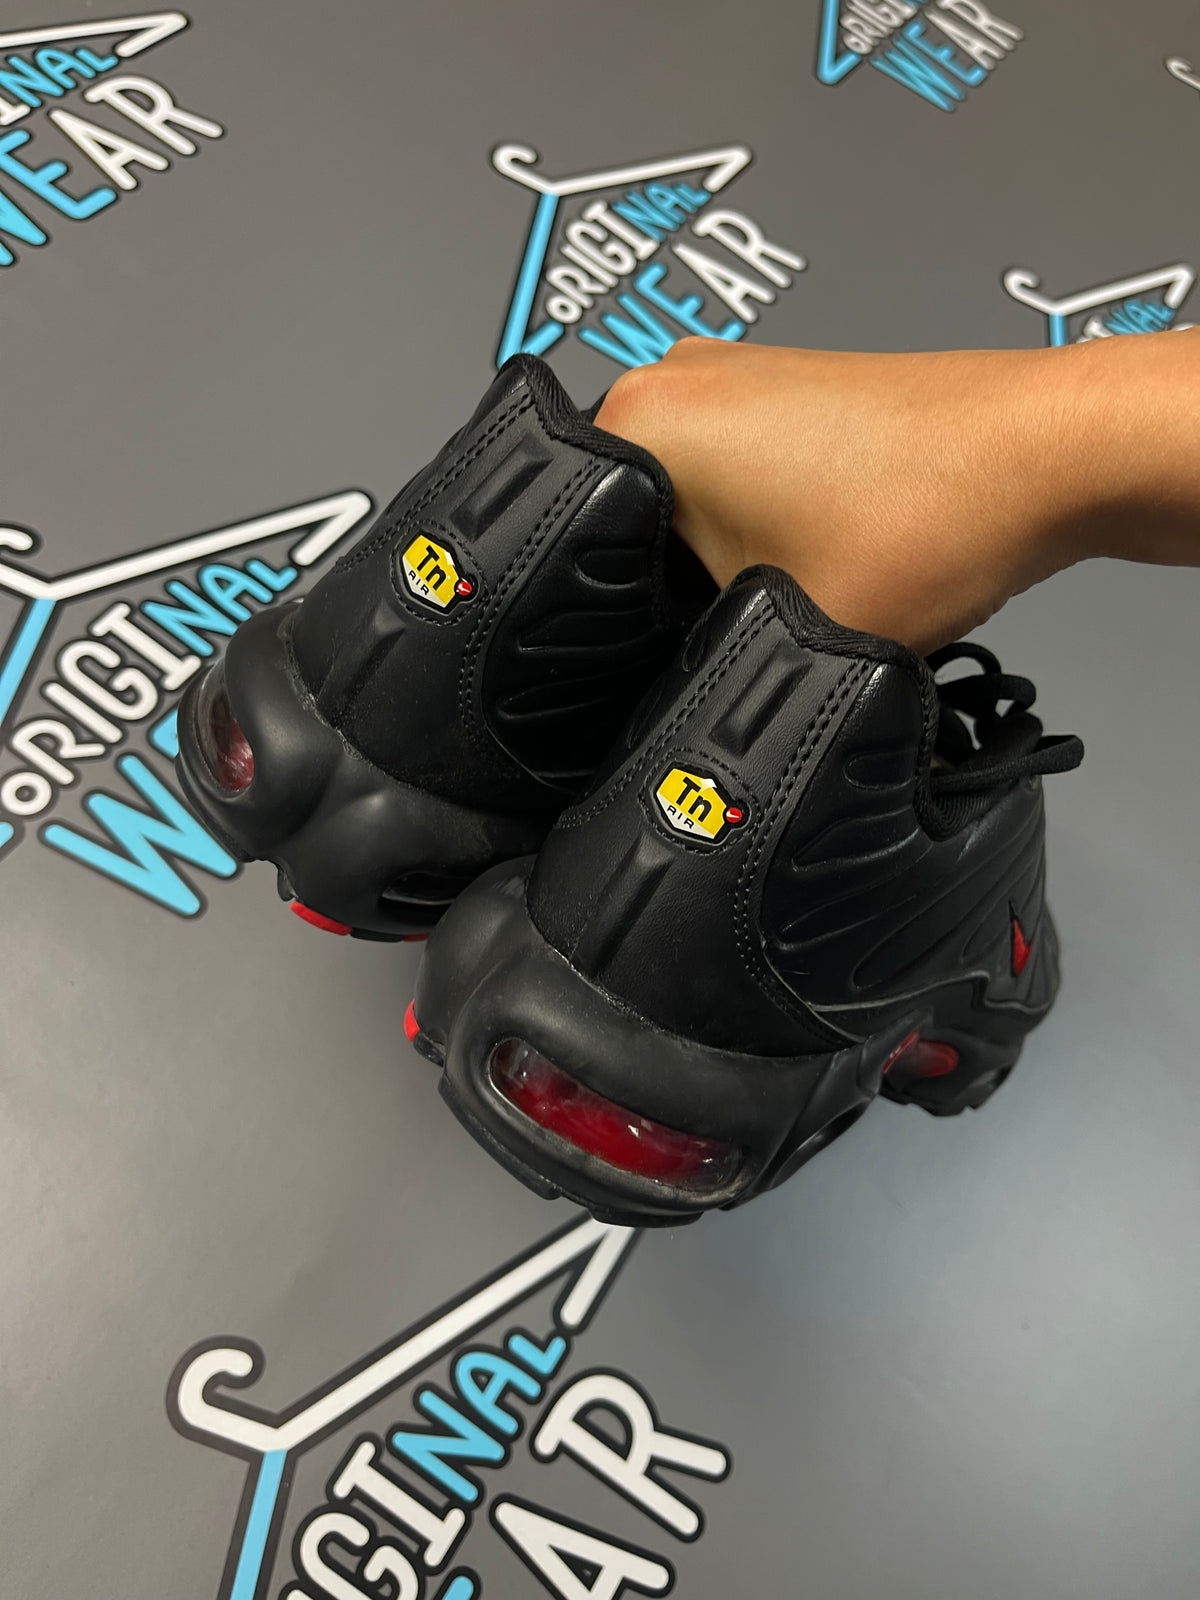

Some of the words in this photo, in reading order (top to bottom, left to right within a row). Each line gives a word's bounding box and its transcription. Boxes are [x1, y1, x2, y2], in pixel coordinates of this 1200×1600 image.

[870, 0, 1024, 112] WEAR
[546, 182, 711, 323] ORIGINAL
[408, 569, 430, 596] AIR
[416, 544, 448, 592] Tn
[0, 558, 298, 816] ORIGINAL
[666, 804, 695, 829] AIR
[675, 776, 712, 823] Tn
[285, 1335, 567, 1600] GINAL
